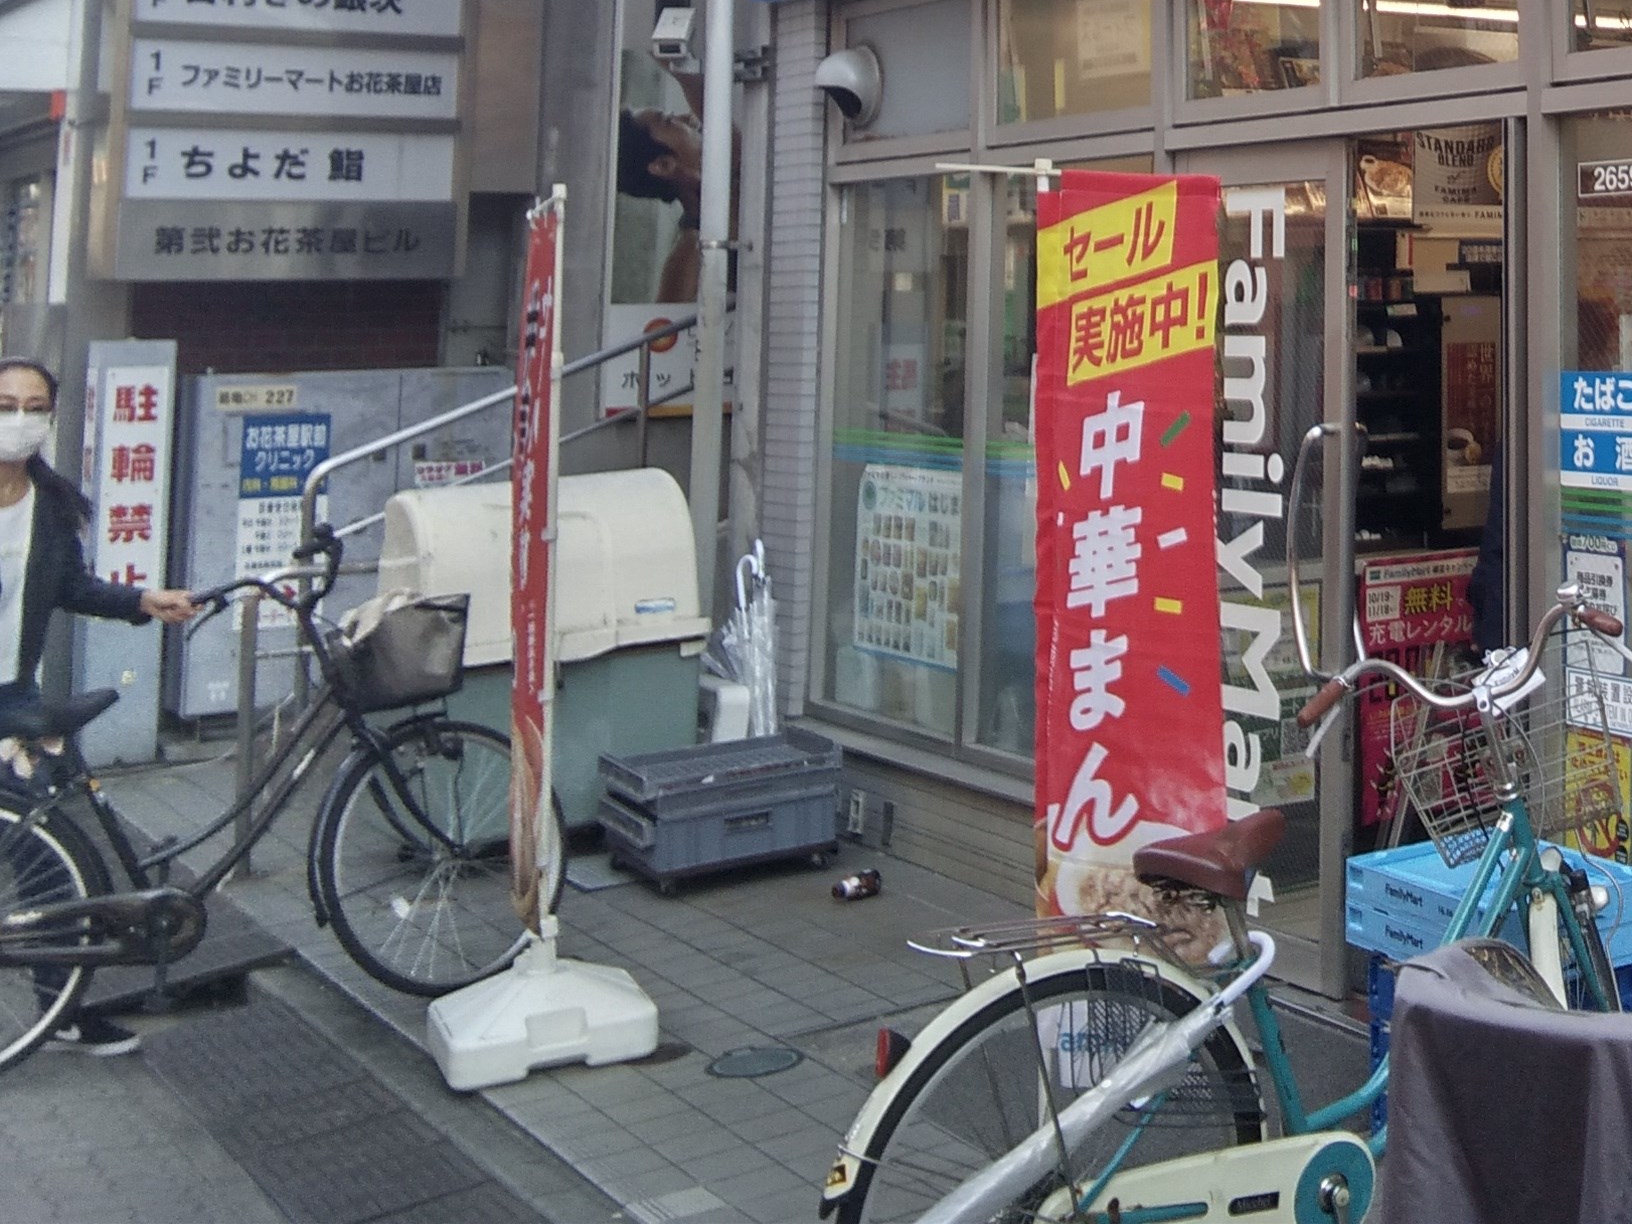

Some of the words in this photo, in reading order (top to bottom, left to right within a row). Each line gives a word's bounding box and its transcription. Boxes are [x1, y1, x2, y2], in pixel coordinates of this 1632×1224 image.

[181, 64, 442, 96] ファミリーマートお花茶屋店
[1416, 131, 1496, 156] STANDARD
[1437, 153, 1474, 168] BLEND
[154, 227, 421, 256] 第弐お花茶屋ビル
[1063, 201, 1166, 282] セール
[1072, 272, 1208, 374] 実施中!
[265, 390, 294, 404] 227
[1585, 417, 1625, 429] CIGARETTE
[246, 424, 327, 449] お花茶屋駅前
[254, 450, 316, 471] クリニック
[107, 382, 159, 588] 駐輪禁止
[1591, 475, 1619, 487] LIQUOR
[1055, 390, 1145, 846] 中華まん
[1368, 615, 1473, 646] 充電レンタル
[1385, 883, 1423, 908] FamilyMart
[1385, 925, 1423, 950] FamilyMart
